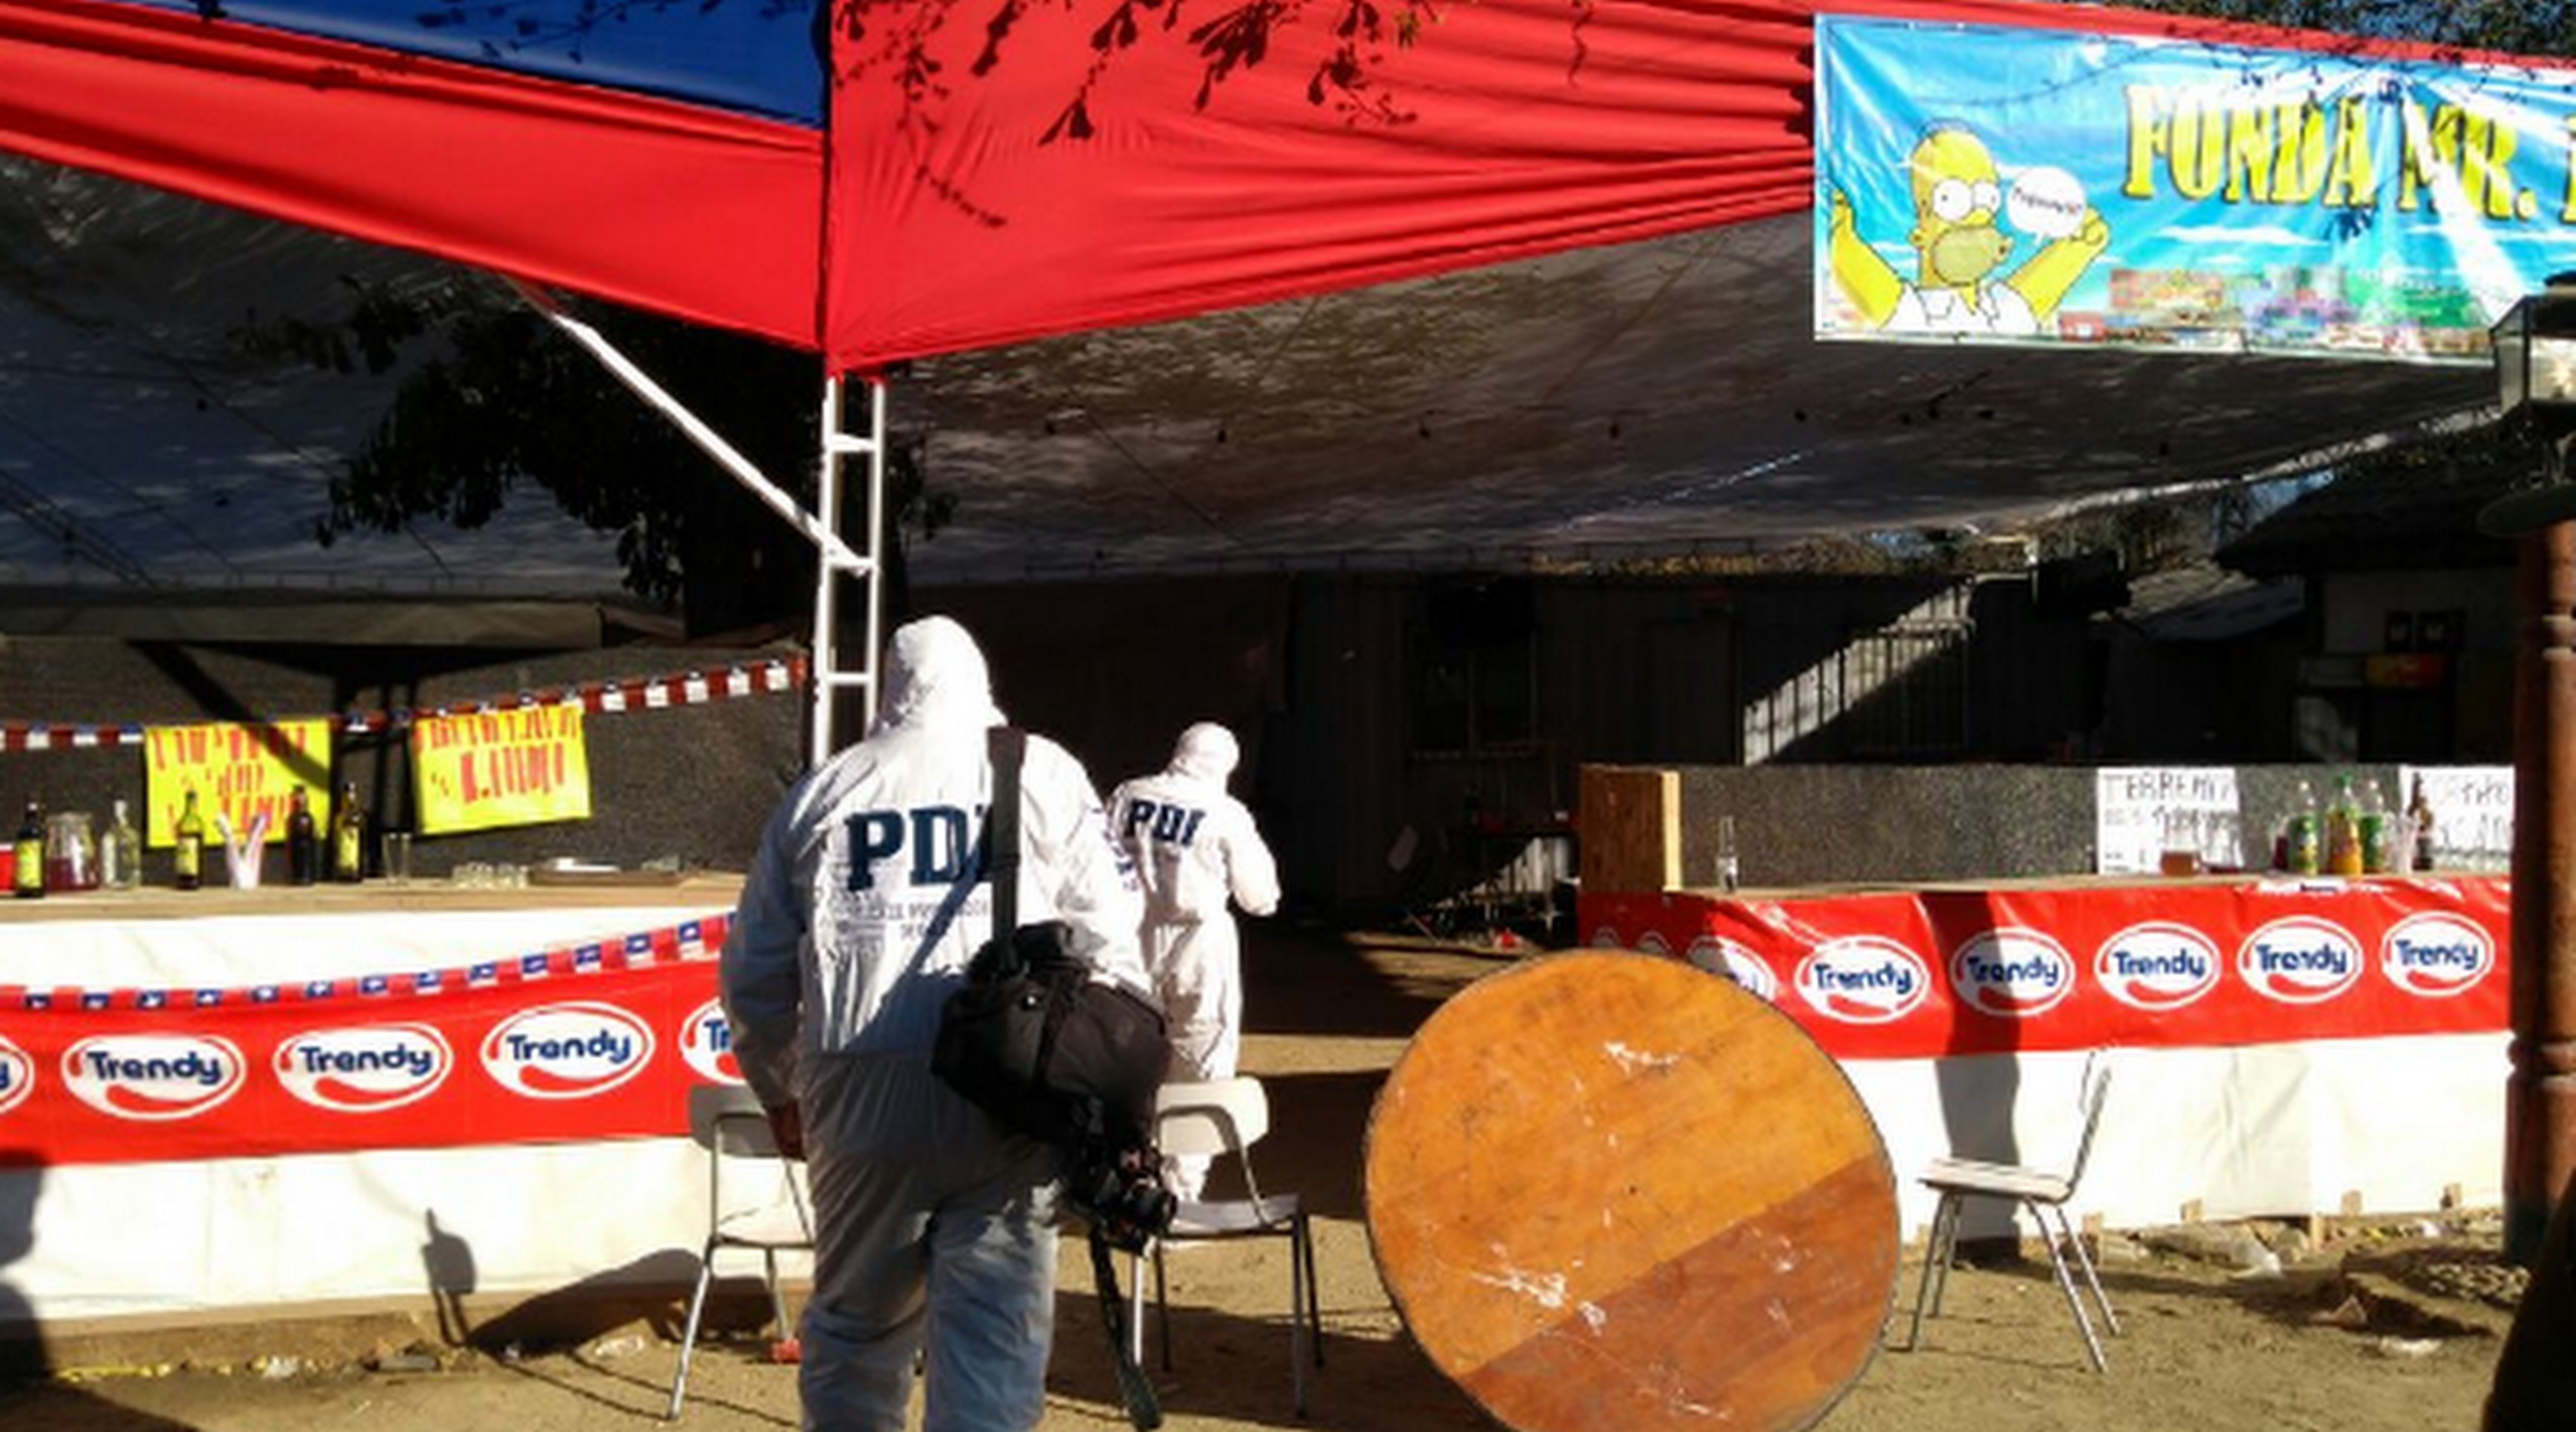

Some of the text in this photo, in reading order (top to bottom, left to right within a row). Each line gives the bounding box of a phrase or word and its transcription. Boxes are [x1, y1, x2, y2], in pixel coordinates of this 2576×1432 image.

[2122, 83, 2376, 207] FONDA
[1123, 799, 1206, 847] PDI
[843, 805, 992, 892] PD
[1967, 956, 2059, 986] Trendy
[2114, 949, 2206, 977] Trendy
[2256, 943, 2347, 974] Trendy
[2395, 940, 2478, 970] Trendy
[1814, 962, 1912, 995] Trendy
[299, 1043, 433, 1076] Trendy
[506, 1029, 631, 1064] Trendy
[86, 1051, 221, 1085] Trendy
